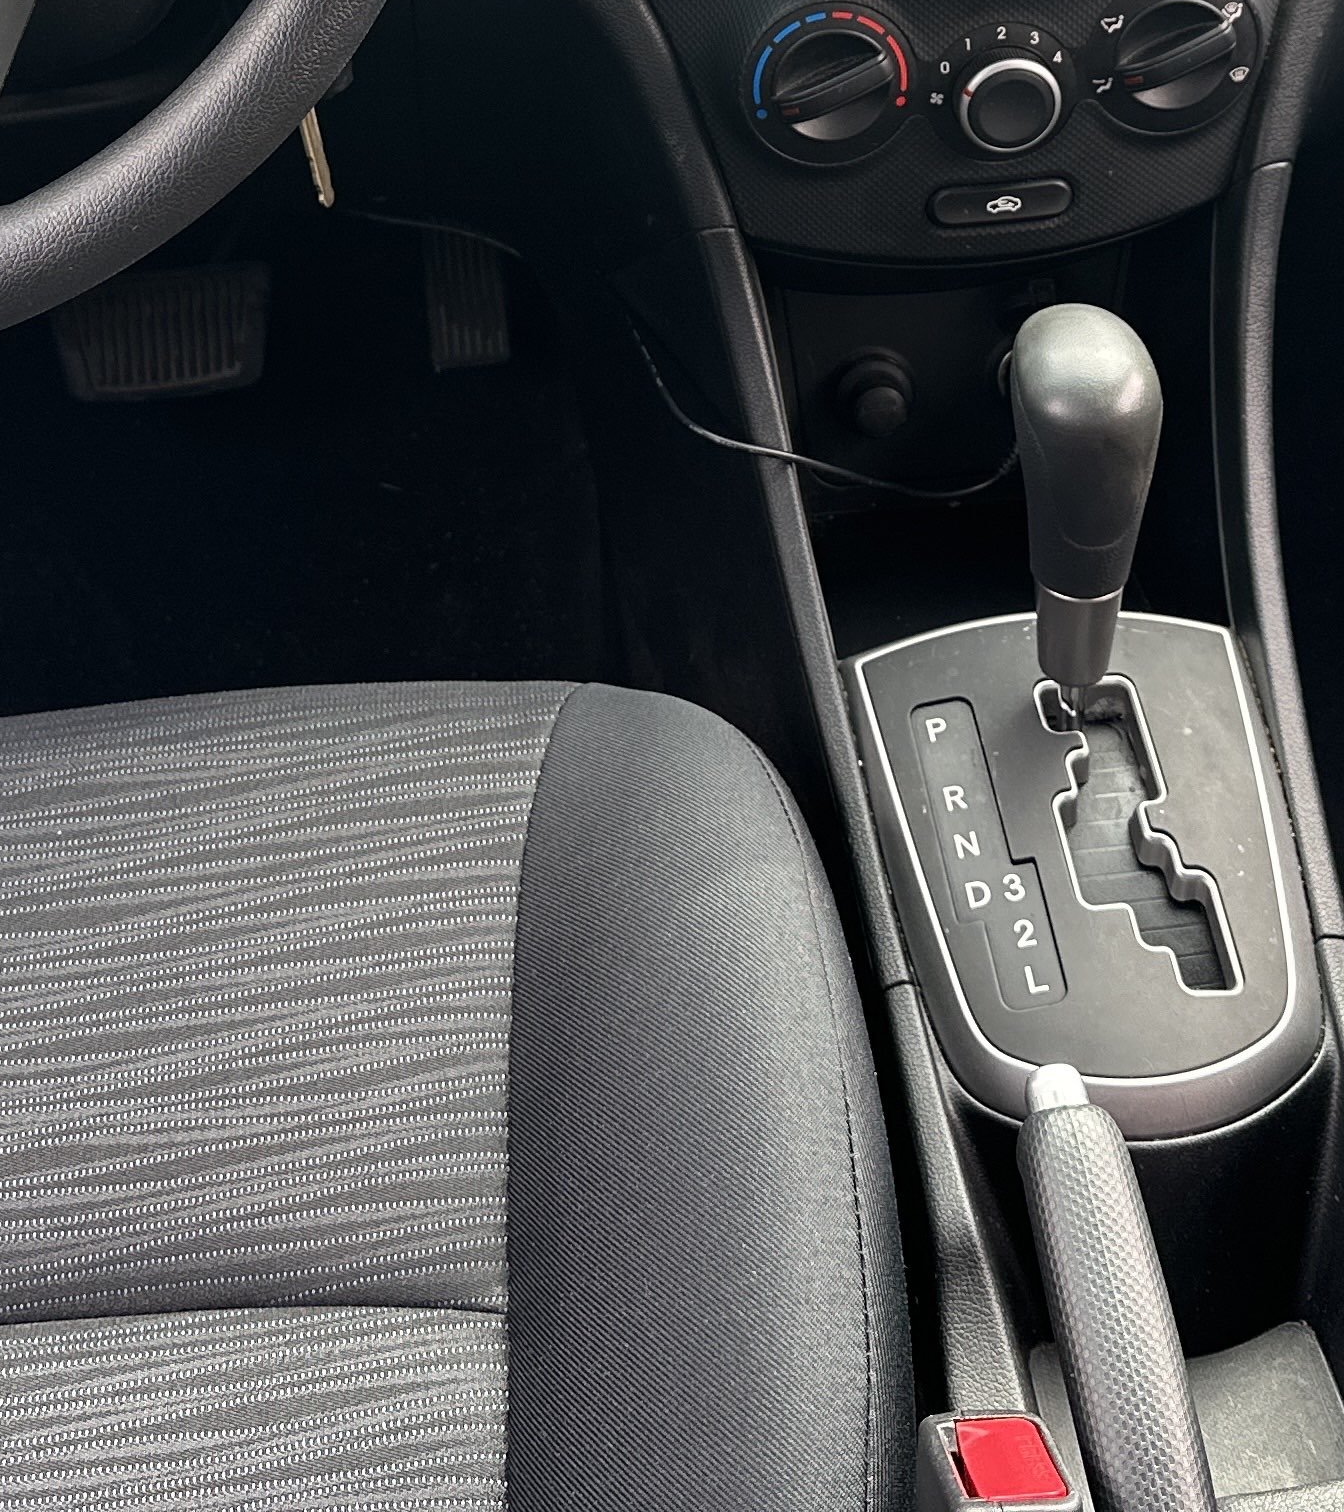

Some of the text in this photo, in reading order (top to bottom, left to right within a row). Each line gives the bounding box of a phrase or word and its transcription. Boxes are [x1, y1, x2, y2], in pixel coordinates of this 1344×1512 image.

[964, 37, 971, 51] 1
[996, 25, 1007, 40] 2
[1029, 31, 1040, 45] 3
[940, 60, 950, 75] 0
[1053, 50, 1062, 65] 4
[924, 716, 948, 743] P
[942, 784, 968, 811] R
[952, 831, 981, 859] N
[964, 873, 1025, 909] D 3
[1012, 919, 1038, 948] 2
[1024, 965, 1050, 994] L
